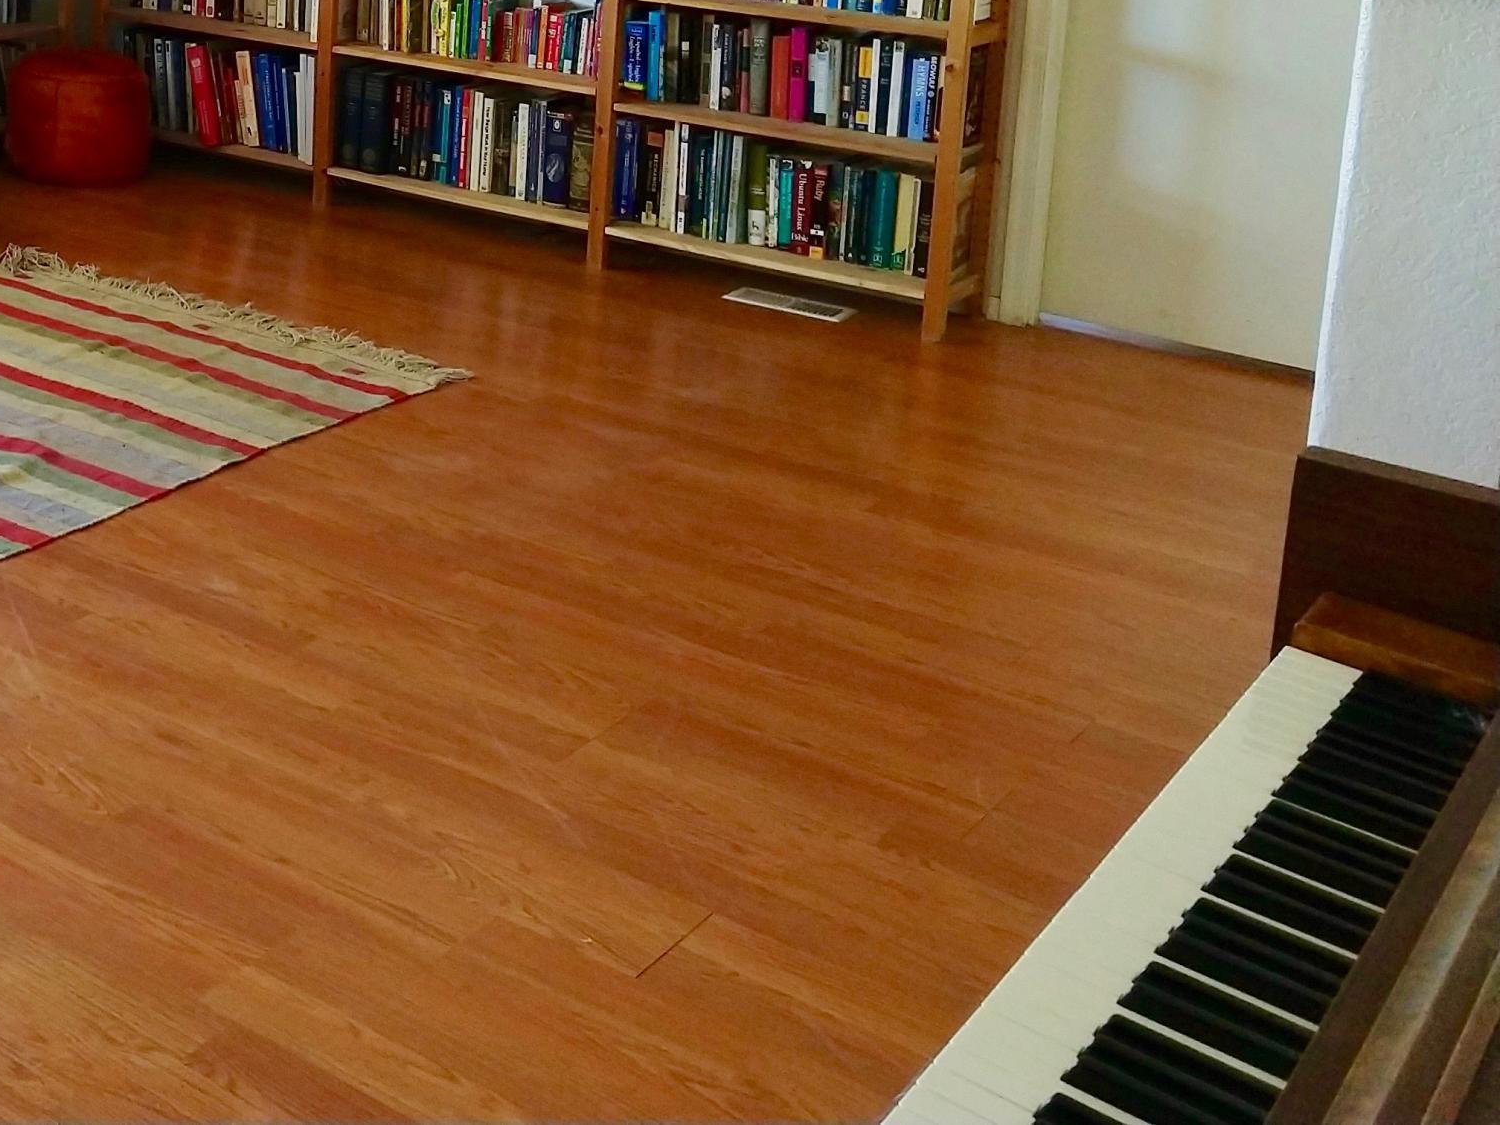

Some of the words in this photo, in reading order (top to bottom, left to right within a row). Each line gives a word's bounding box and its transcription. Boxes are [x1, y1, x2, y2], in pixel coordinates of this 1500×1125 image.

[915, 65, 926, 97] HYMNS
[929, 56, 937, 89] BEOWULF
[798, 173, 807, 204] Ubuntu
[813, 179, 825, 201] Ruby
[796, 207, 805, 231] Linux
